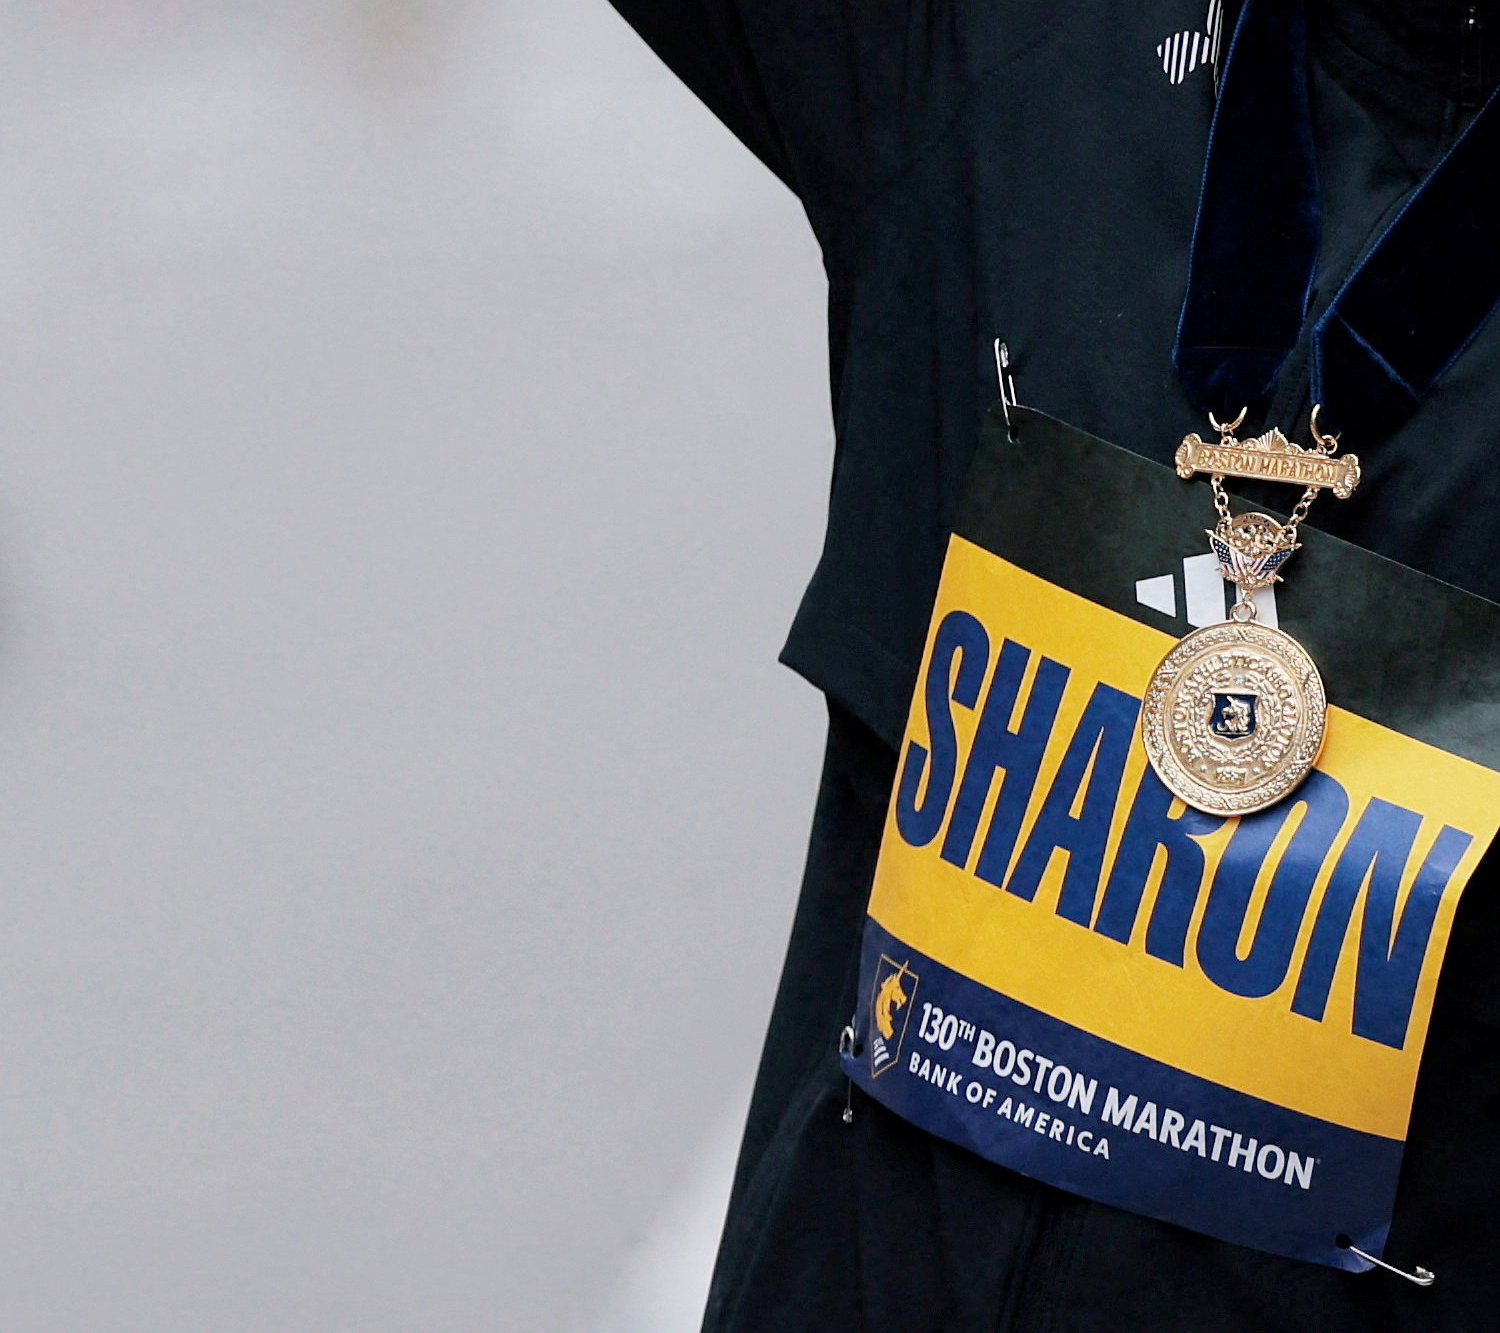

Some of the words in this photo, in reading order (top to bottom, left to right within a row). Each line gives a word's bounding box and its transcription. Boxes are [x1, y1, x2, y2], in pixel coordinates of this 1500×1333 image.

[1199, 449, 1257, 474] BOSTON
[1259, 456, 1337, 484] MARATHON
[895, 609, 1475, 1051] SHARON
[908, 1051, 963, 1096] BANK
[966, 1081, 997, 1109] OF
[997, 1097, 1110, 1160] AMERICA
[918, 1002, 977, 1051] 130TH
[972, 1029, 1098, 1115] BOSTON
[1101, 1086, 1315, 1190] MARATHON
